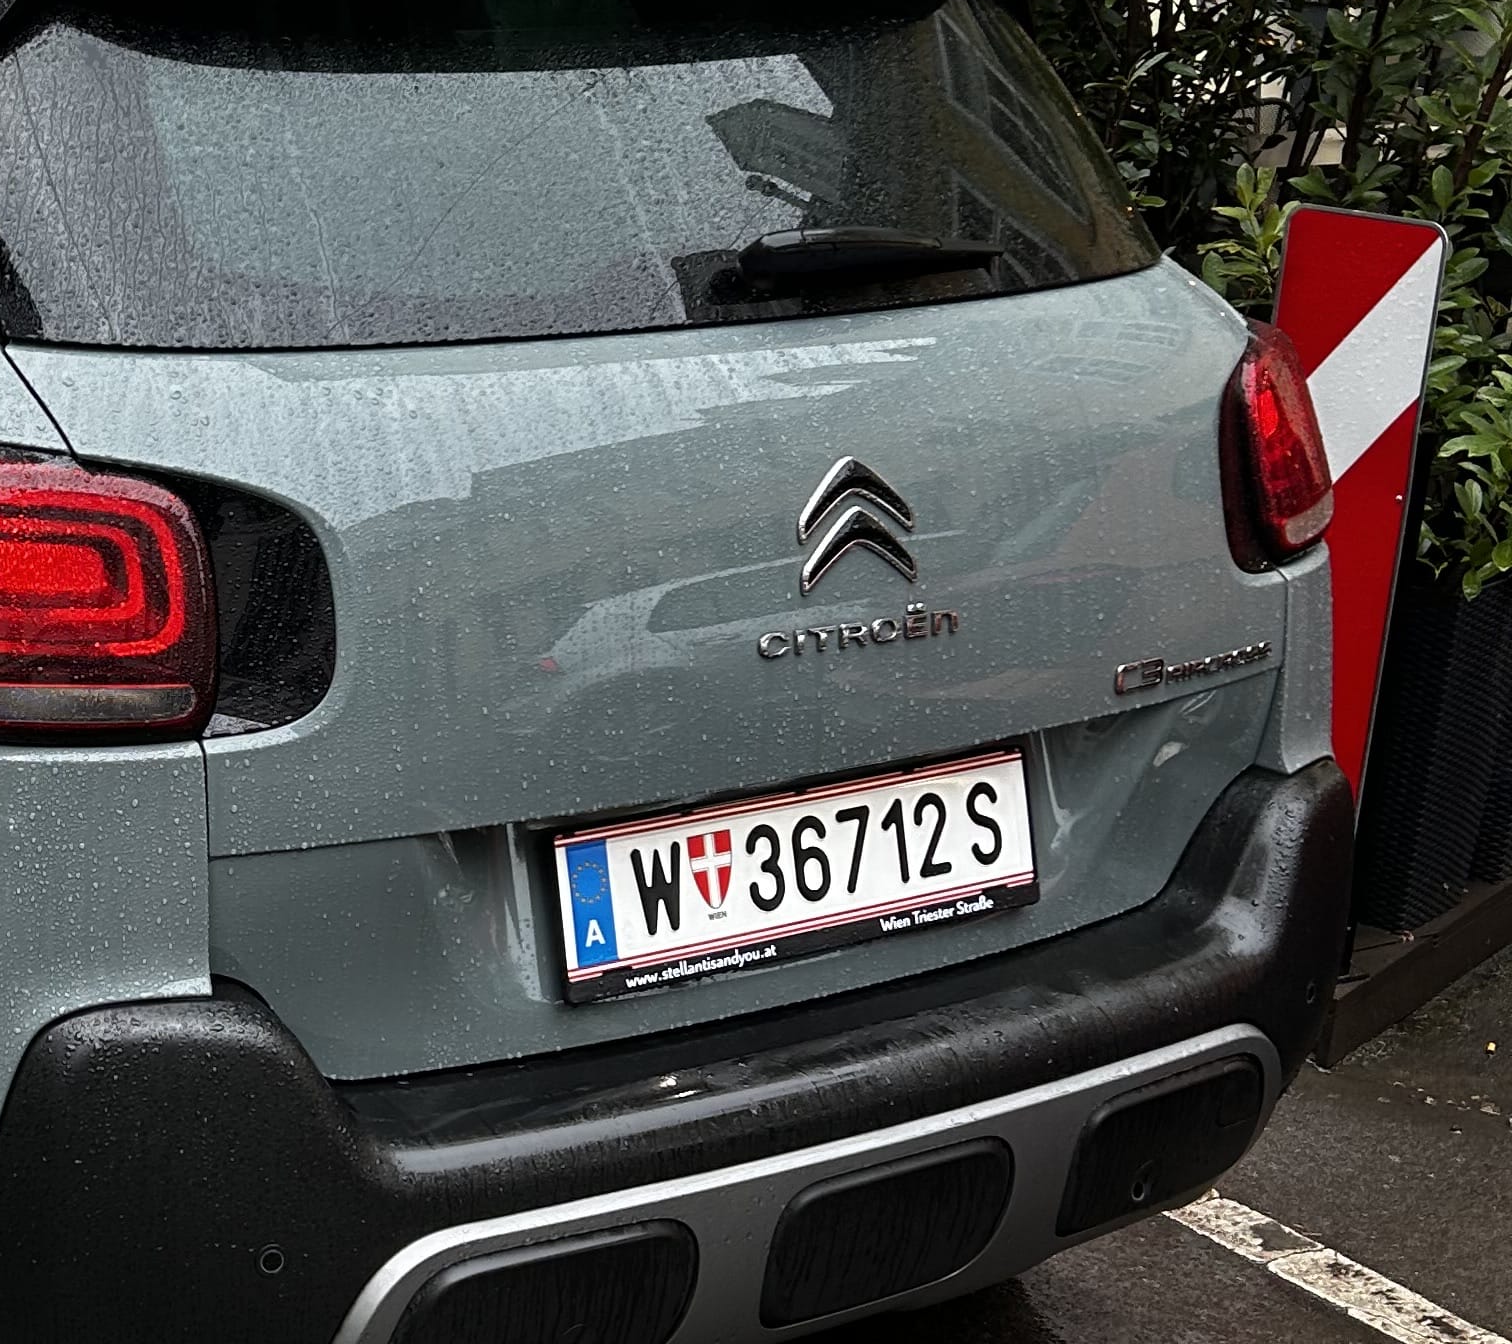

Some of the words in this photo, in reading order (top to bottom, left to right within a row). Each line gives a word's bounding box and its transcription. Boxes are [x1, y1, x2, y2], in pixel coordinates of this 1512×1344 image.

[1115, 657, 1164, 695] C3
[630, 840, 681, 936] W
[745, 792, 952, 912] 36712
[966, 782, 1003, 866] S
[708, 910, 728, 921] WIEN
[879, 916, 911, 932] Wien
[911, 906, 955, 925] Triester
[956, 894, 995, 915] Straße
[585, 919, 606, 948] A
[625, 944, 777, 989] www.stellantisandyou.at
